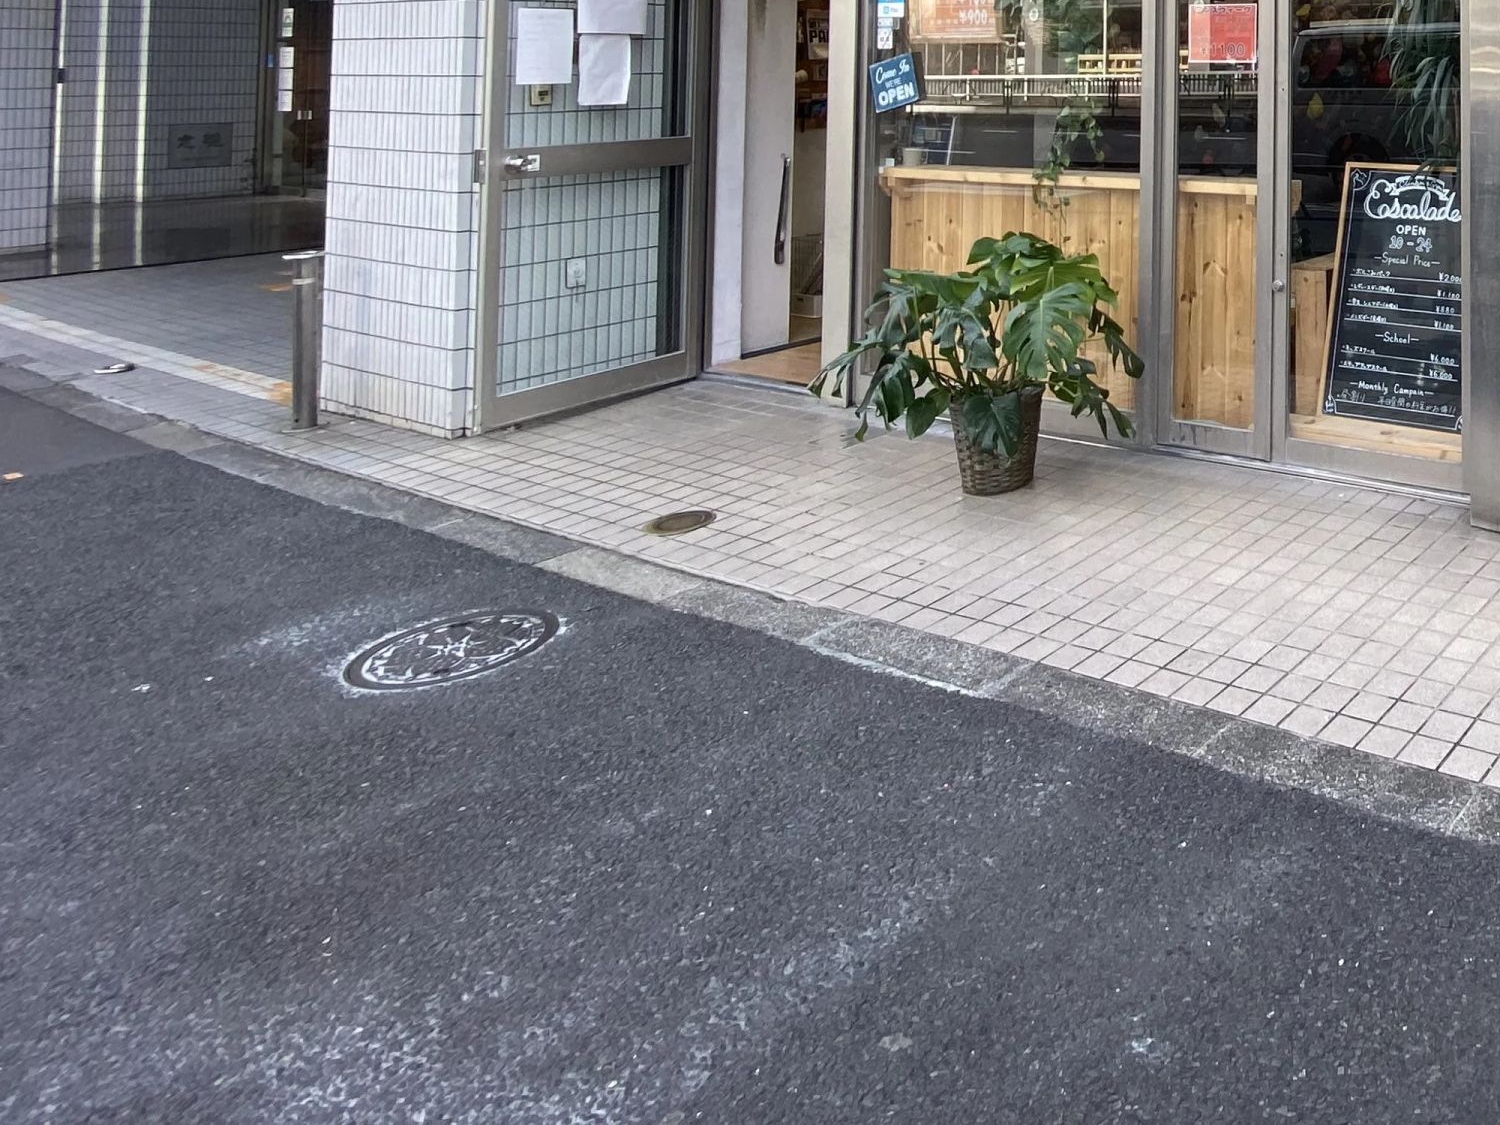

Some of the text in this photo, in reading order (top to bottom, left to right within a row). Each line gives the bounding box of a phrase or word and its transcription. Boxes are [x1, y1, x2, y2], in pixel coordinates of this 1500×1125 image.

[876, 59, 911, 84] Come In
[878, 82, 915, 106] OPEN
[1364, 179, 1462, 222] Escalade
[1396, 224, 1427, 236] OPEN
[1357, 381, 1388, 394] Monthly
